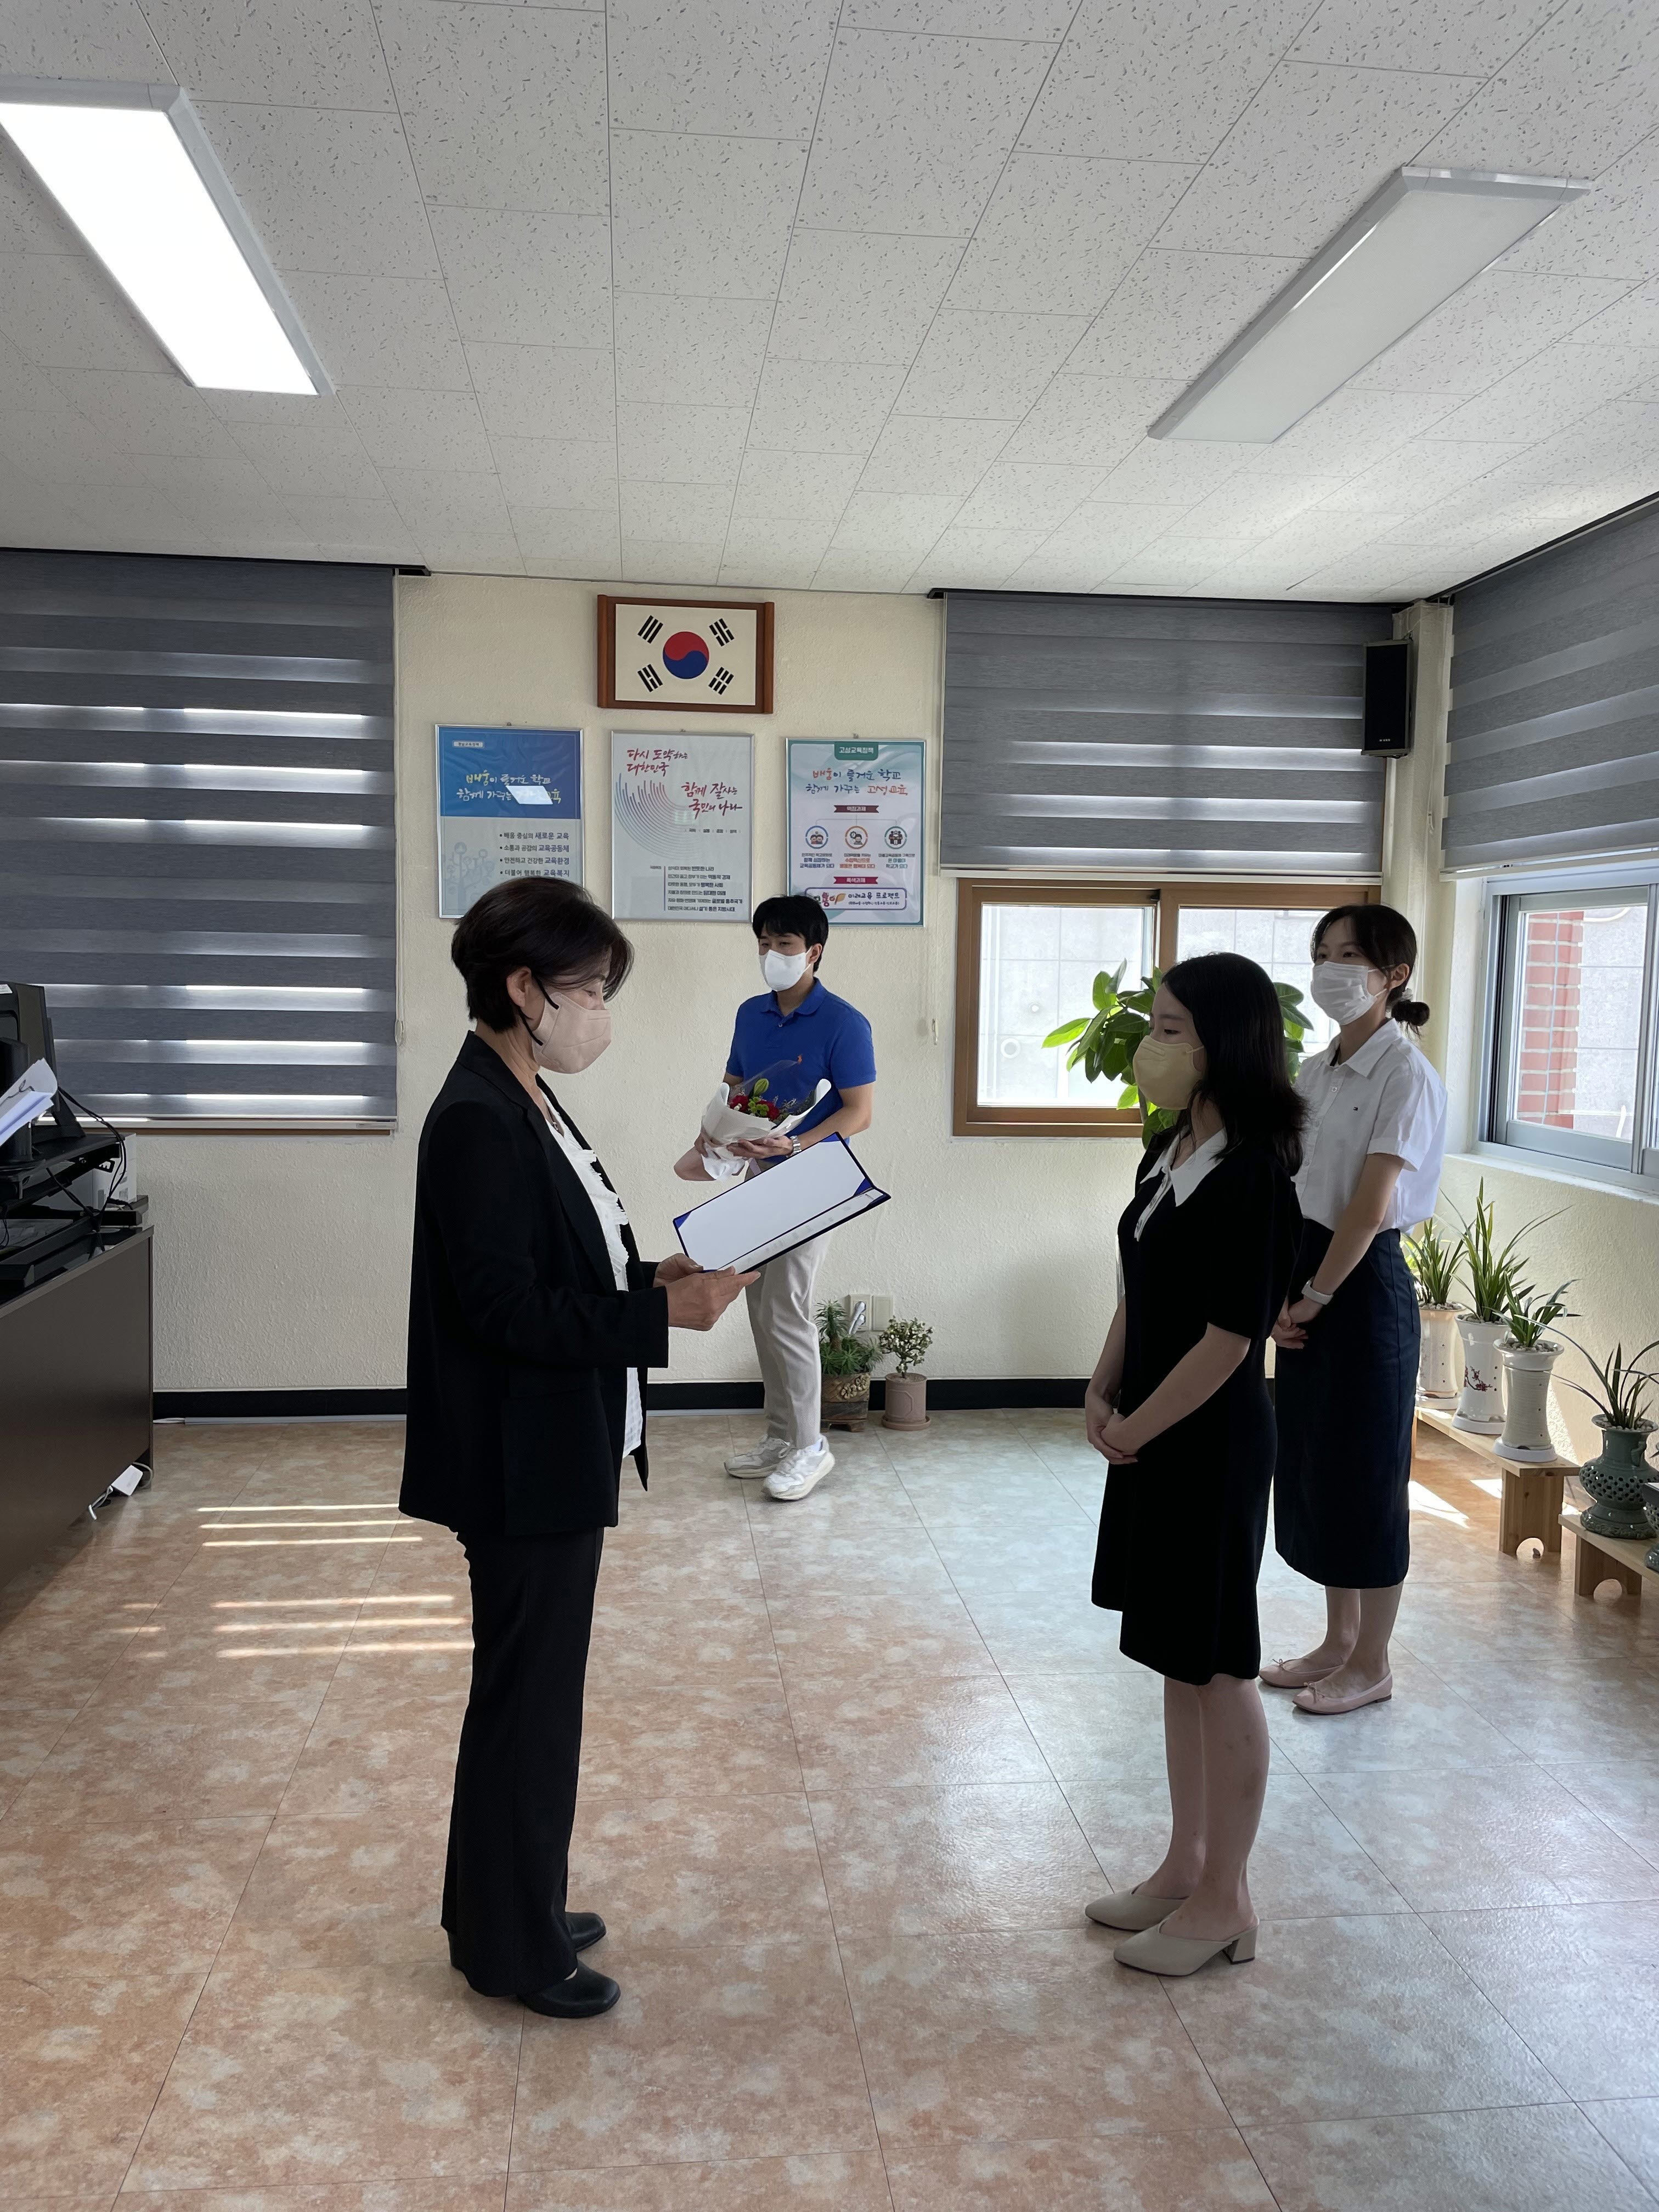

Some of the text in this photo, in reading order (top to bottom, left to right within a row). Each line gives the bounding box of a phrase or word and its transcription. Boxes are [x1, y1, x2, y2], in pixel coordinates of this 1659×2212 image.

[627, 748, 689, 761] 다시 도약하는
[627, 761, 669, 777] 대한민국
[812, 768, 901, 782] 배움이 즐거운 학교
[466, 770, 551, 786] 배움이 즐거운 학교
[456, 788, 483, 802] 함께
[487, 791, 512, 801] 가꾸는
[681, 782, 737, 800] 함께 잘사는
[805, 783, 828, 794] 함께
[834, 784, 860, 794] 가꾸는
[689, 799, 743, 820] 국민의 나라
[848, 892, 873, 900] 미래교육
